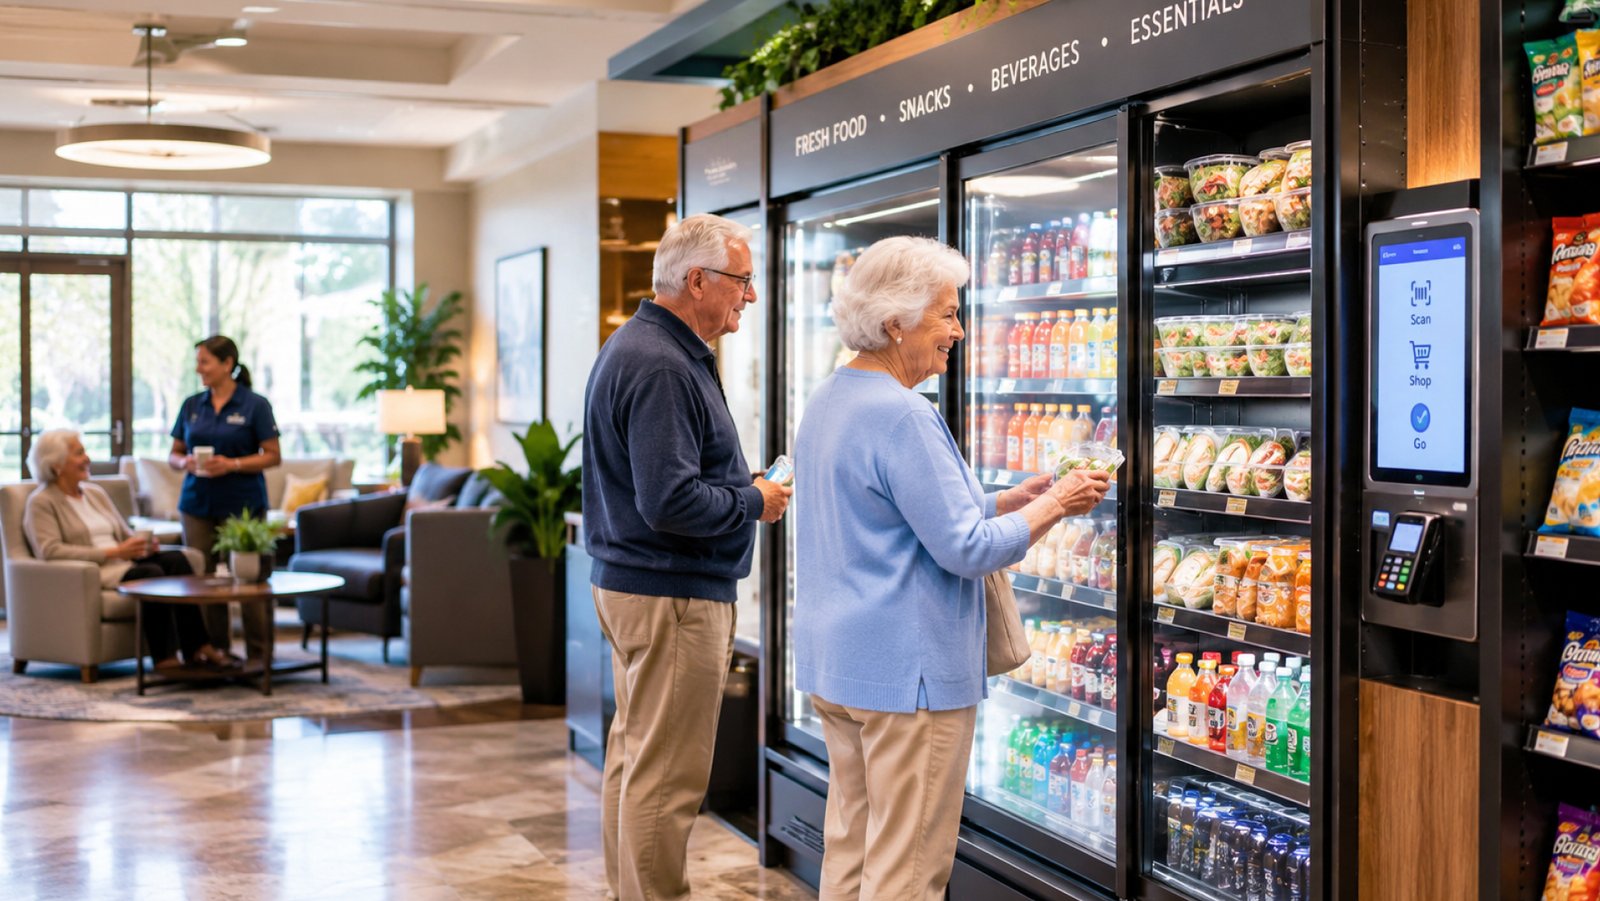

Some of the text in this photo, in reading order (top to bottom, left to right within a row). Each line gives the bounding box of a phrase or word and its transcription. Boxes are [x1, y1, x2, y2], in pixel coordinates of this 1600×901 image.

[795, 127, 830, 157] FRESH
[833, 114, 867, 144] FOOD
[899, 85, 951, 122] SNACKS
[991, 39, 1080, 92] BEVERAGES
[1410, 314, 1431, 325] Scan
[1409, 375, 1432, 389] Shop
[1413, 437, 1427, 450] Go
